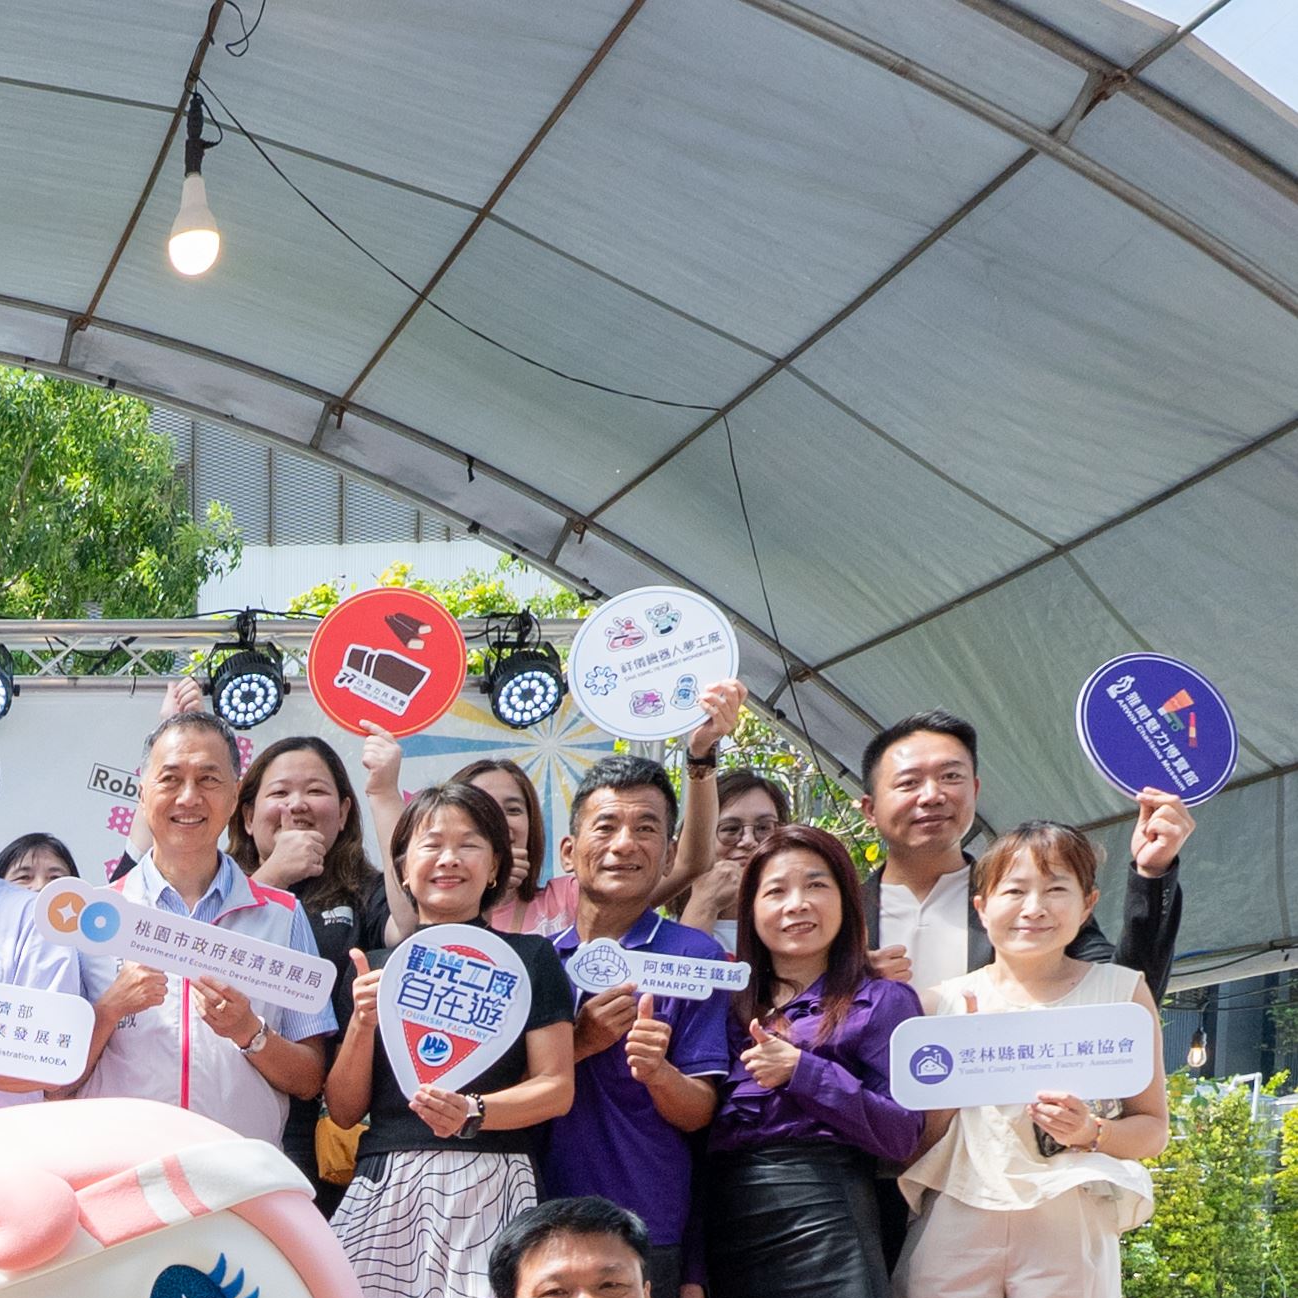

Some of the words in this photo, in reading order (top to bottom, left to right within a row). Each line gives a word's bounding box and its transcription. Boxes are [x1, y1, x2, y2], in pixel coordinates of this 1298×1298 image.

[130, 939, 178, 962] Department
[178, 955, 188, 963] of
[189, 957, 227, 976] Economic
[134, 918, 324, 989] 桃園市政府經濟發展局
[406, 943, 519, 1000] 觀光工廠
[643, 959, 744, 984] 阿媽牌生鐵鍋
[396, 971, 507, 1033] 自在遊
[400, 1007, 444, 1027] TOURISM
[446, 1021, 489, 1040] FACTORY
[39, 1054, 68, 1067] MOEA
[958, 1037, 1135, 1064] 雲林縣觀光工廠協會
